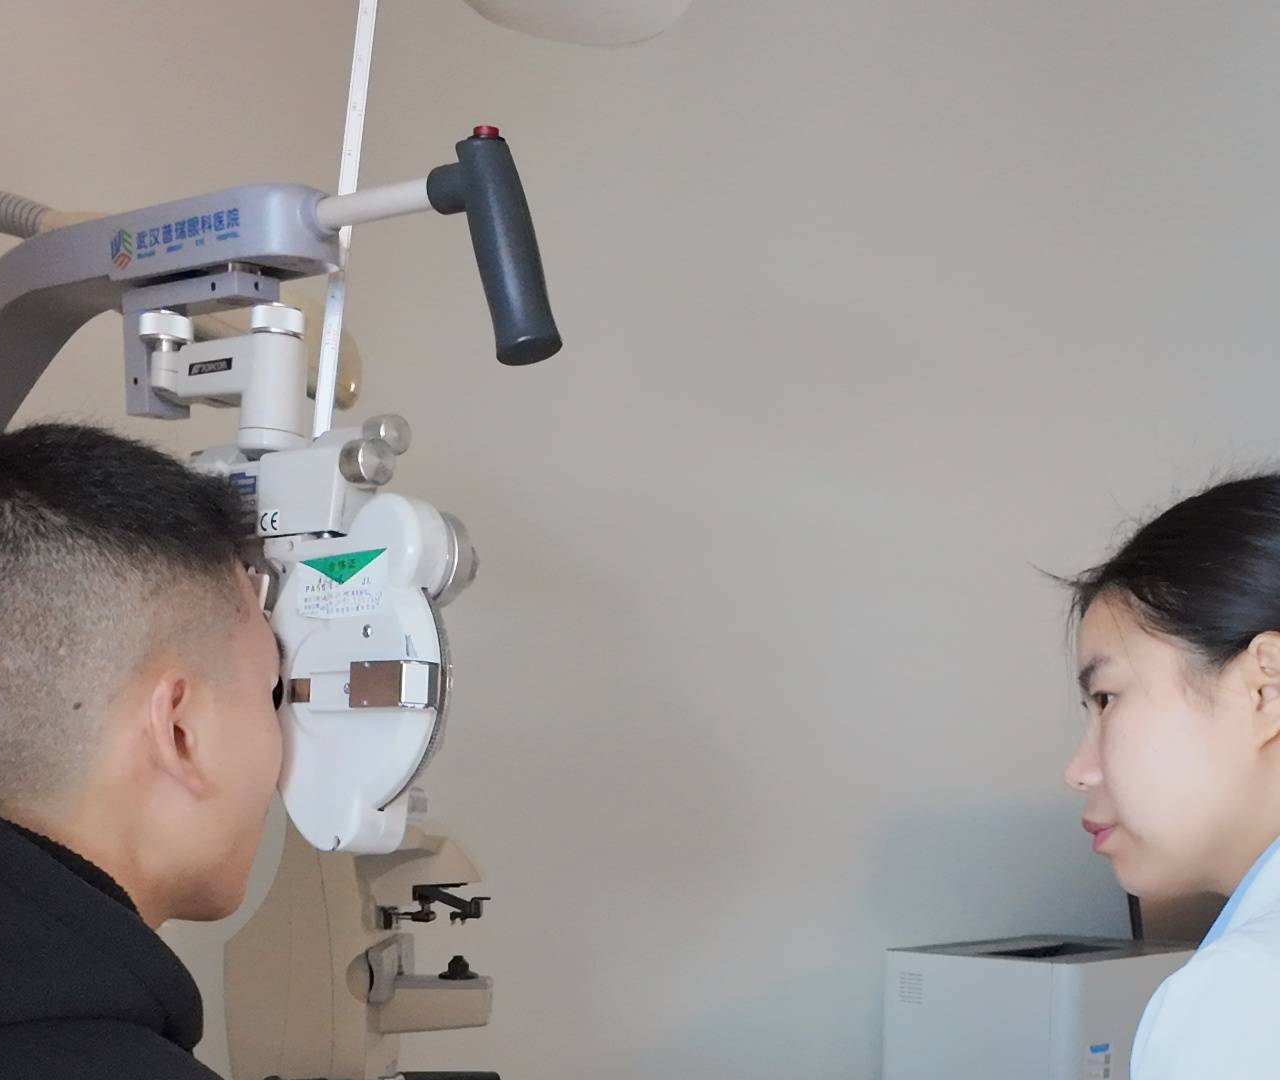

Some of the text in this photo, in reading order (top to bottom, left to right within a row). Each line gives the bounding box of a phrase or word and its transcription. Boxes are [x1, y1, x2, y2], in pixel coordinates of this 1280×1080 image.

[136, 207, 240, 249] 武汉普瑞眼科医院
[260, 512, 278, 531] CE
